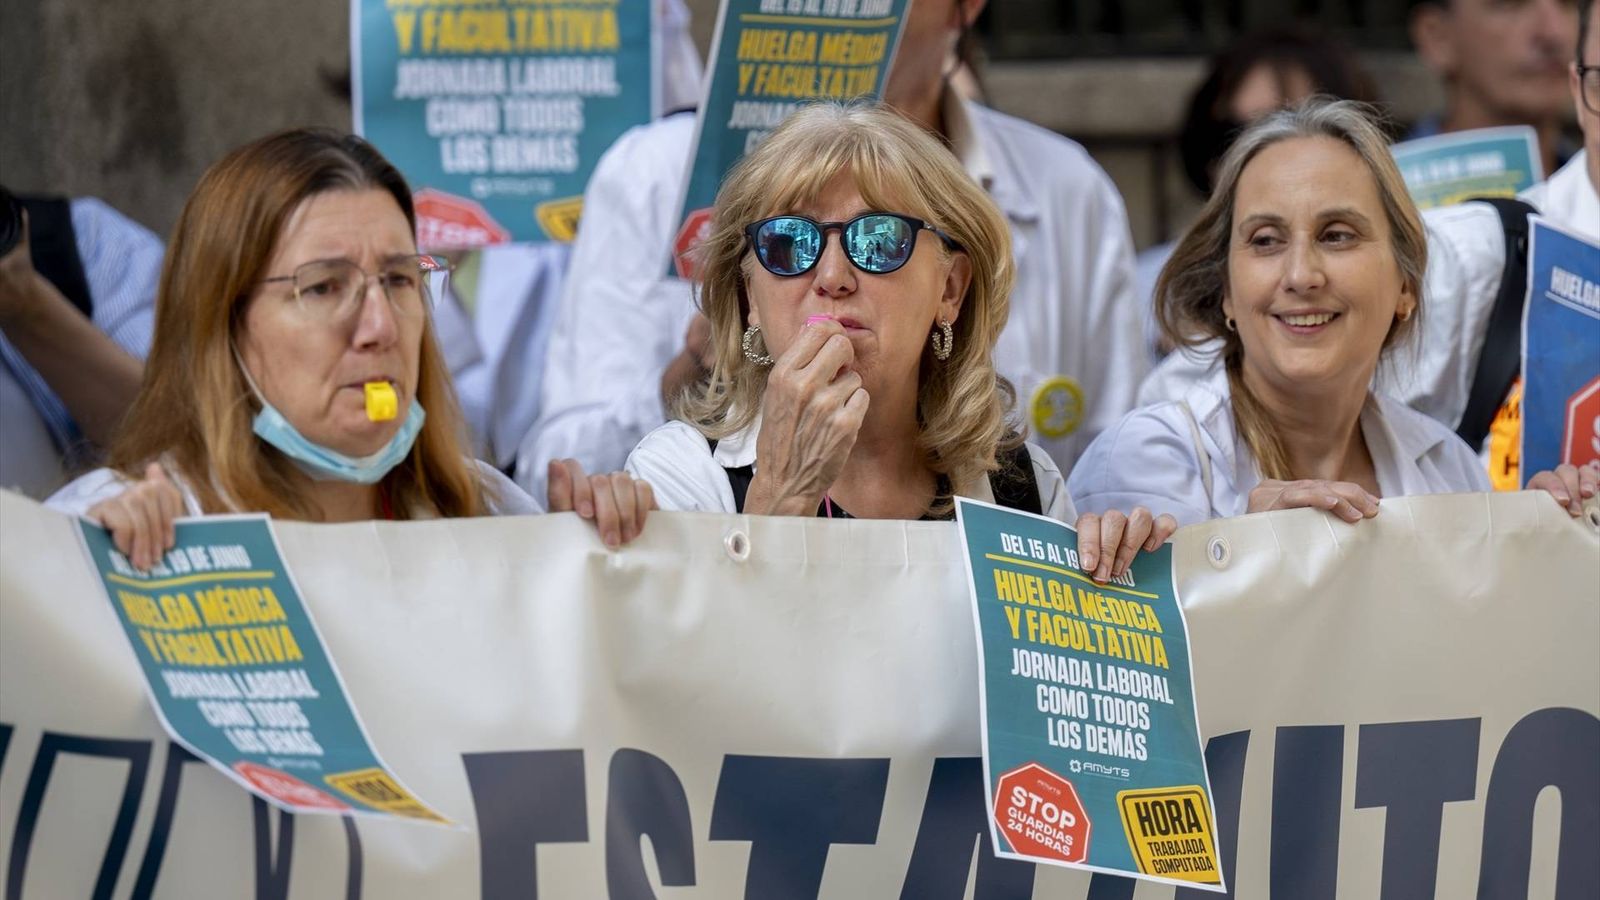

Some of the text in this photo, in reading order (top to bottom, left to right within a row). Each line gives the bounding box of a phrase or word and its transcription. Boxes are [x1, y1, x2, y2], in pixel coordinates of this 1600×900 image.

[737, 28, 818, 63] HUELGA
[738, 62, 755, 96] Y
[1000, 532, 1080, 570] DEL 15 AL 19
[118, 584, 288, 630] HUELGA MÉDICA
[993, 568, 1080, 616] HUELGA
[1078, 588, 1163, 633] MÉDICA
[138, 629, 162, 664] Y
[1004, 605, 1169, 670] Y FACULTATIVA
[1011, 648, 1174, 705] JORNADA LABORAL
[1036, 684, 1151, 731] COMO TODOS
[1047, 717, 1148, 762] LOS DEMÁS
[1083, 762, 1130, 777] AMYTS
[1007, 806, 1074, 847] GUARDIAS
[1010, 786, 1076, 830] STOP
[1134, 798, 1204, 838] HORA
[1007, 819, 1071, 857] 24 HORAS
[1147, 838, 1207, 857] TRABAJADA
[1152, 856, 1215, 874] COMPUTADA
